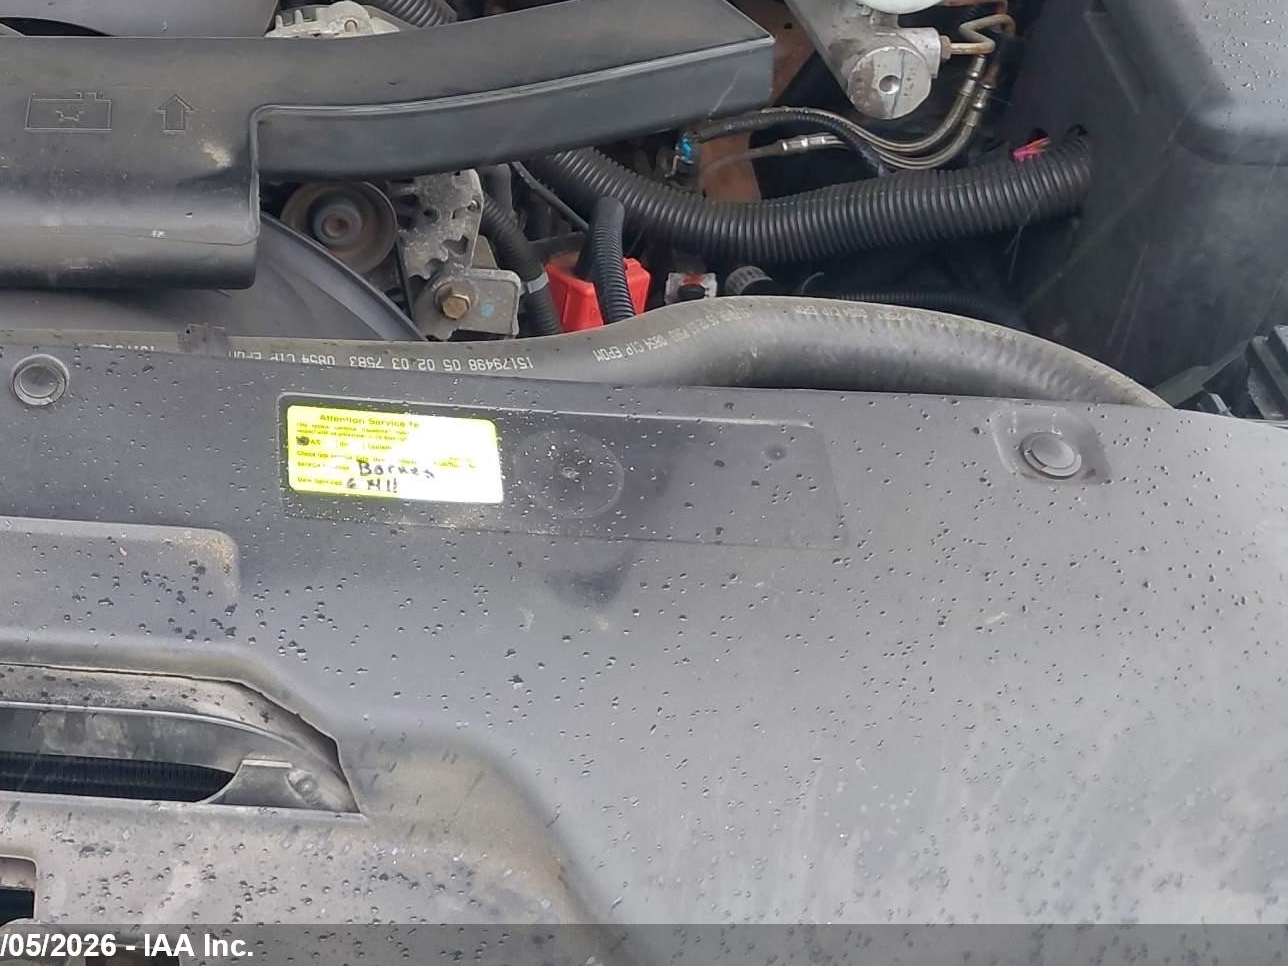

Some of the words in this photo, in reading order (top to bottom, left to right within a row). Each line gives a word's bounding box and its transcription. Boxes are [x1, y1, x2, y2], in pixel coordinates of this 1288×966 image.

[592, 346, 623, 362] EPDM
[349, 355, 385, 369] 7583
[391, 357, 410, 371] 03
[416, 358, 435, 371] 02
[442, 358, 461, 371] 05
[319, 414, 365, 424] Attention
[368, 418, 406, 428] Service
